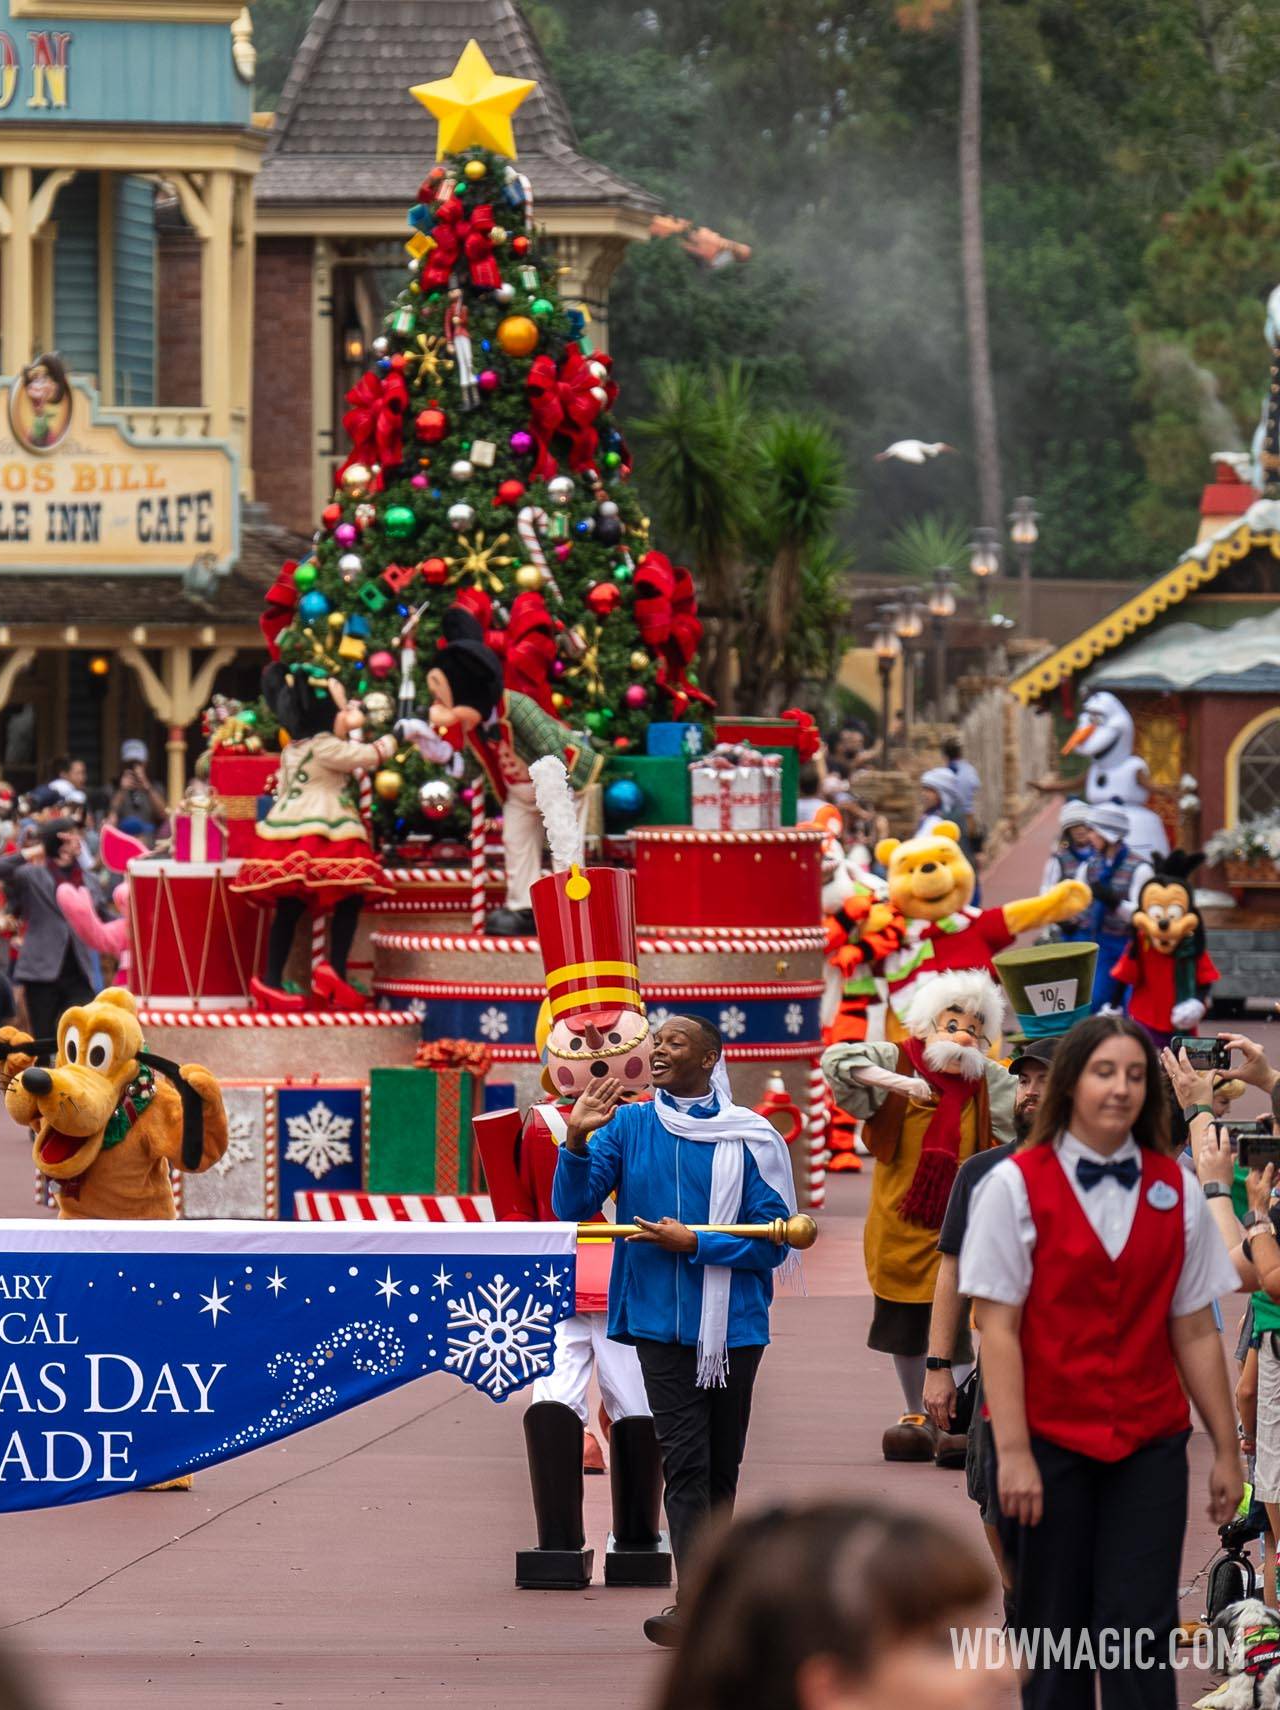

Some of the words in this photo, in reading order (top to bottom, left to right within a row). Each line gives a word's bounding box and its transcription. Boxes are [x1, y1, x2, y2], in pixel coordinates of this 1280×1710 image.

[72, 462, 166, 493] BILL
[46, 501, 102, 542] INN
[136, 489, 213, 543] CAFE
[1038, 986, 1066, 1013] 10/6
[83, 1353, 227, 1413] DAY
